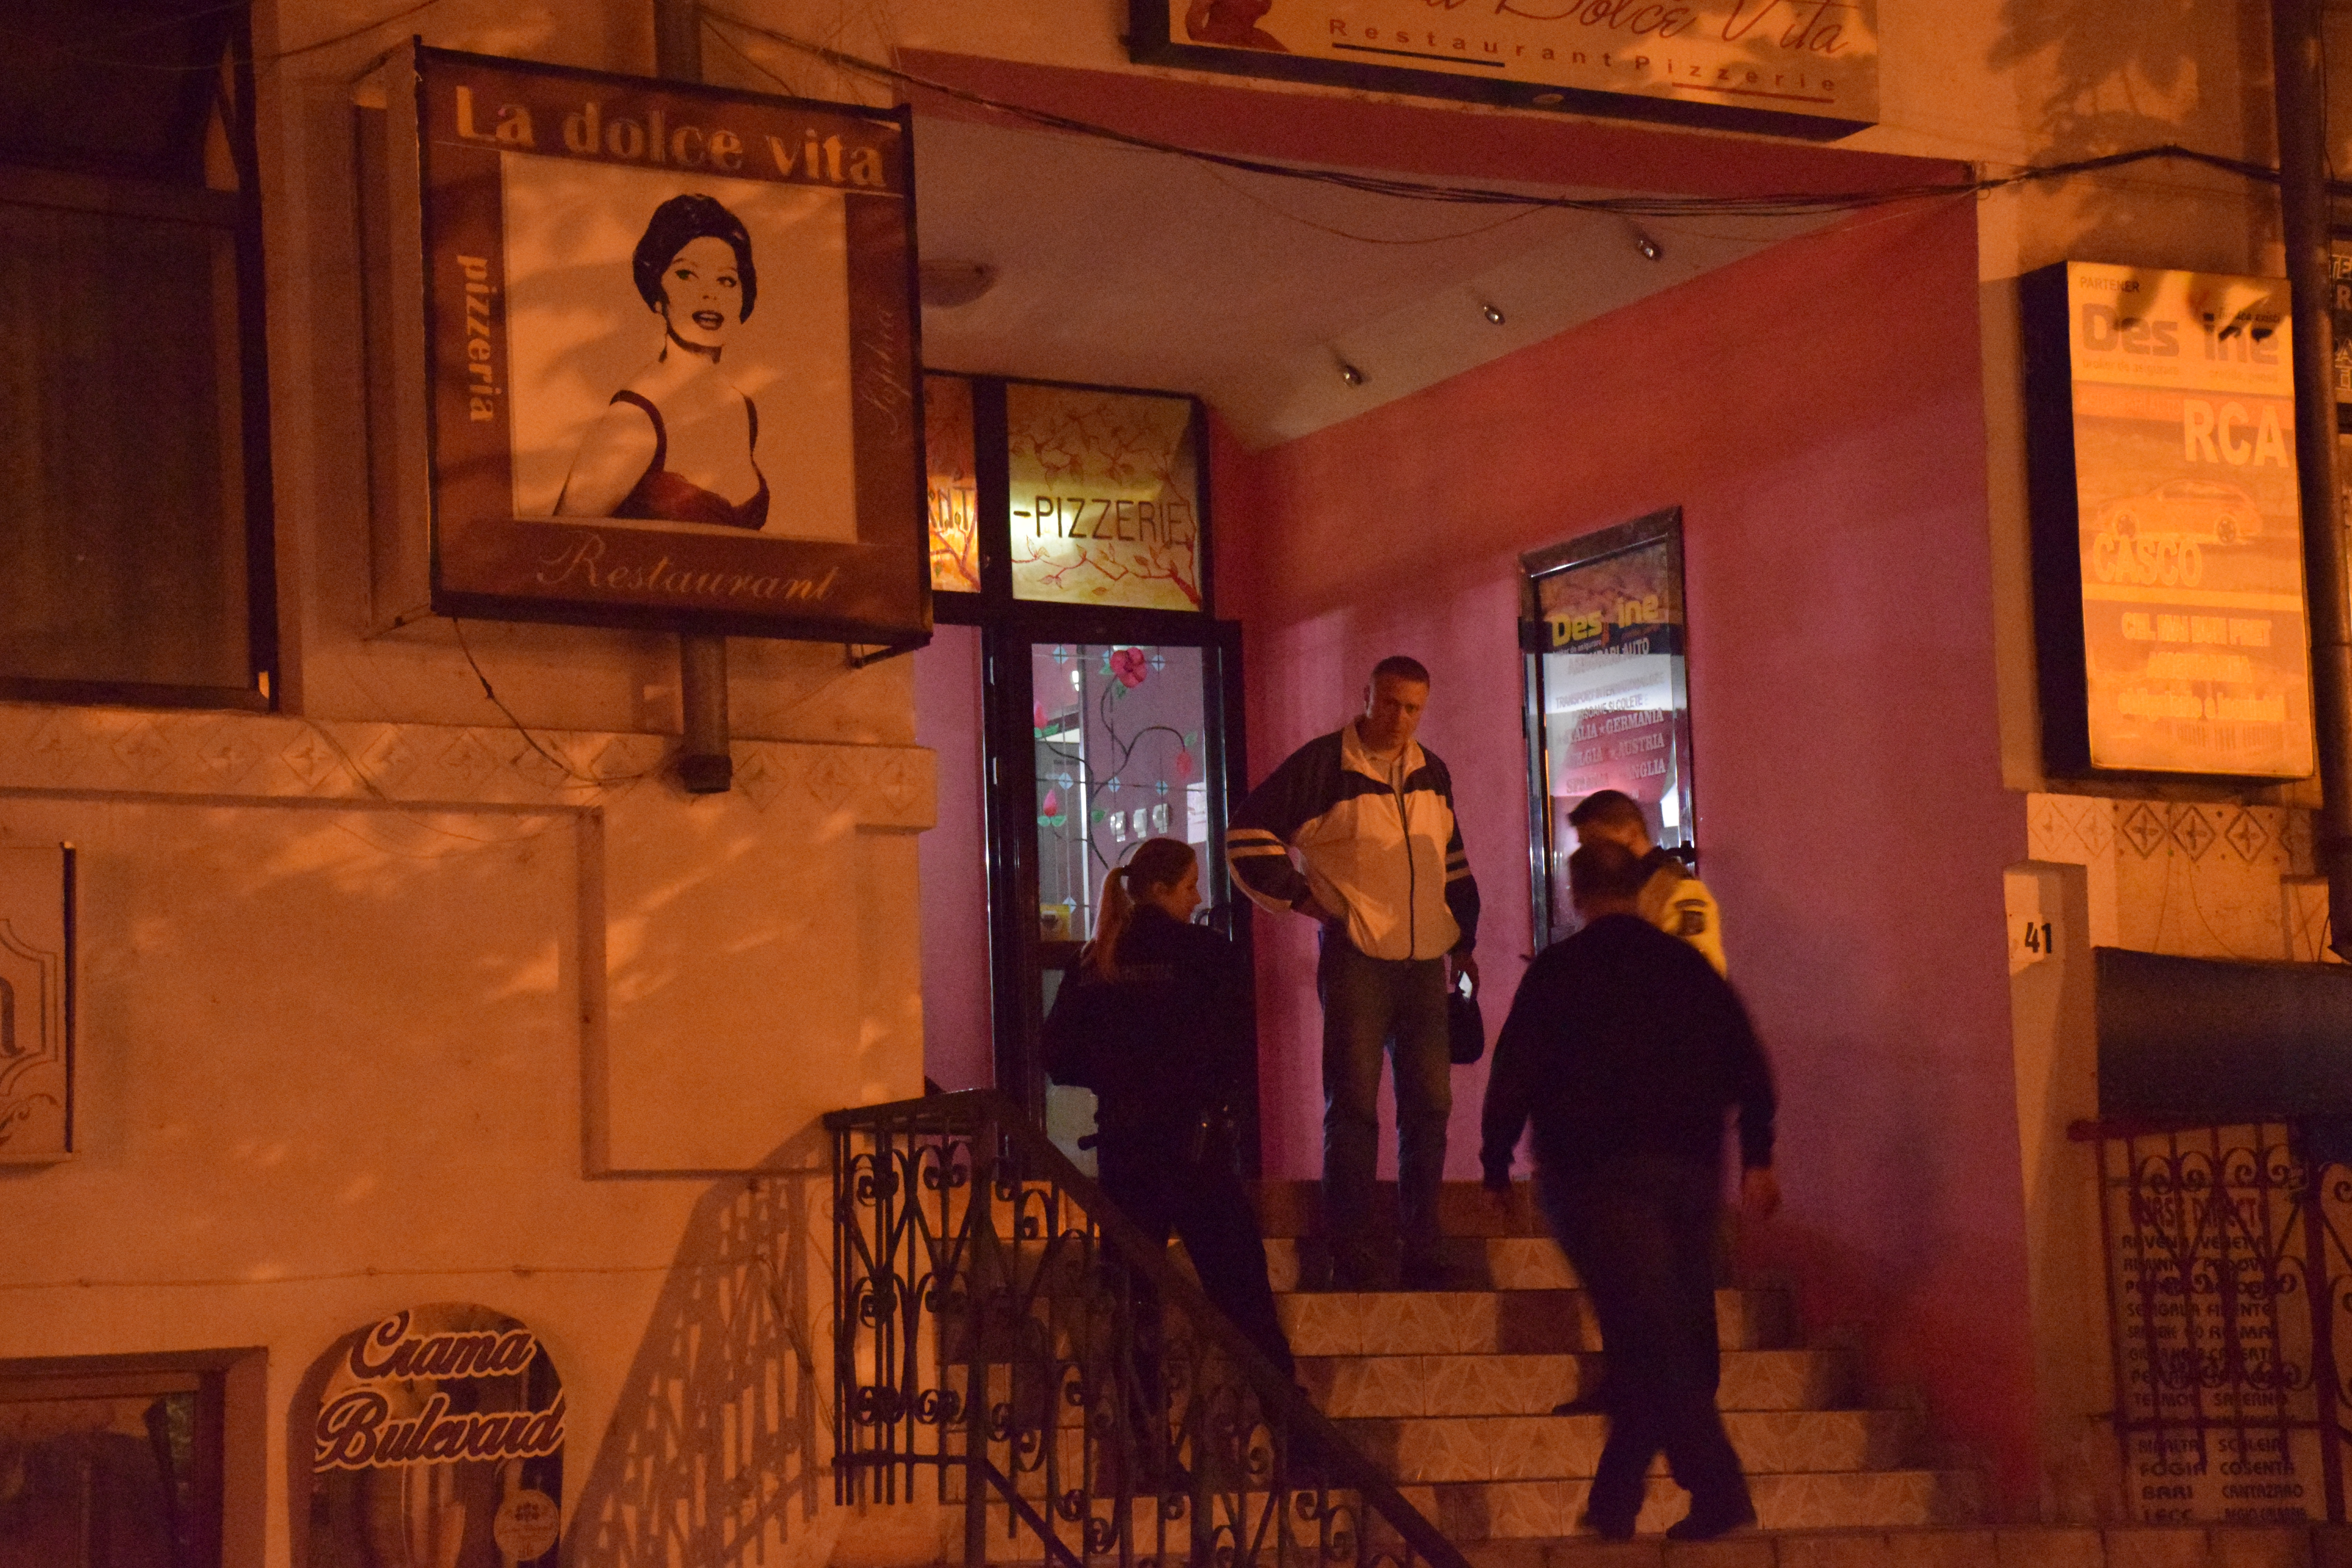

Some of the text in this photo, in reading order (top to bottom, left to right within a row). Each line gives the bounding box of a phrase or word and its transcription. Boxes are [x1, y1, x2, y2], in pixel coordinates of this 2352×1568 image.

[1330, 18, 1835, 91] Restaurant Pizzerie
[456, 85, 887, 188] La dolce vita
[2080, 276, 2140, 293] PARTENER
[457, 255, 503, 421] pizzeria
[2183, 399, 2290, 468] RCA
[535, 532, 840, 601] Restaurant
[2092, 532, 2203, 587] CASCO
[1606, 707, 1664, 735] GERMANIA
[2024, 922, 2052, 954] 41
[350, 1308, 537, 1382] Crama
[314, 1387, 566, 1474] Bulevard
[2142, 1485, 2193, 1499] BARI
